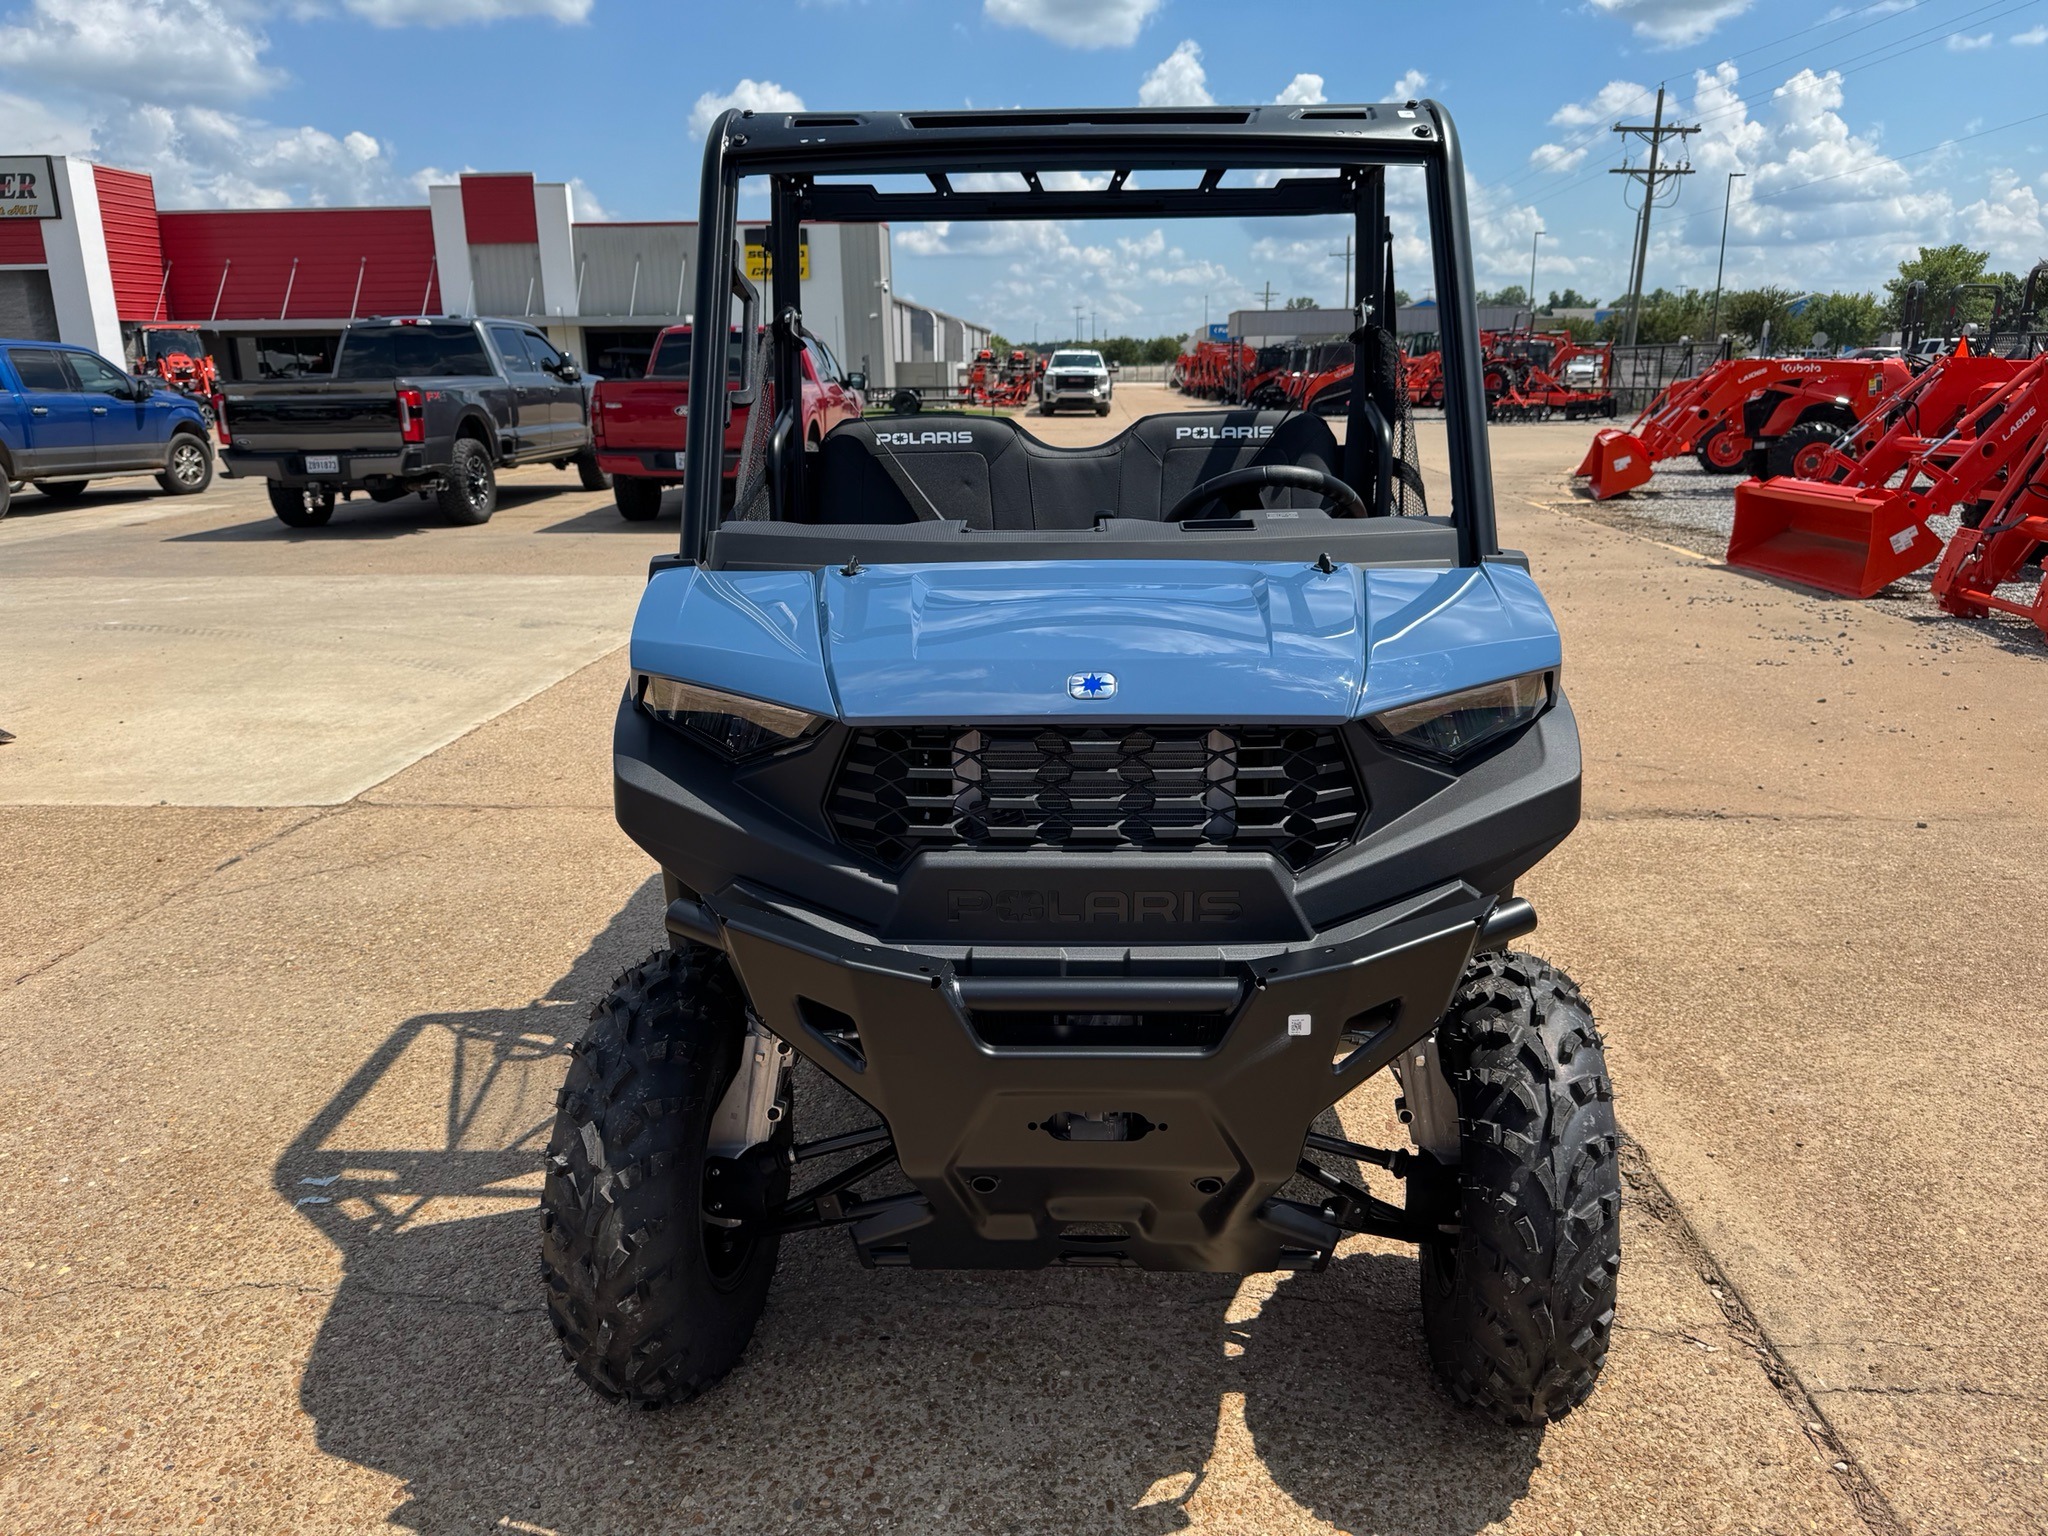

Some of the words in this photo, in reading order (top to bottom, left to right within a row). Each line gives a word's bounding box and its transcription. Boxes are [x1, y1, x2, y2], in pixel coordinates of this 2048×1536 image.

[1781, 363, 1821, 373] Kubota
[2002, 406, 2037, 441] LA806
[876, 431, 973, 445] POLARIS
[1176, 426, 1274, 439] POLARIS
[948, 889, 1244, 923] POLARIS
